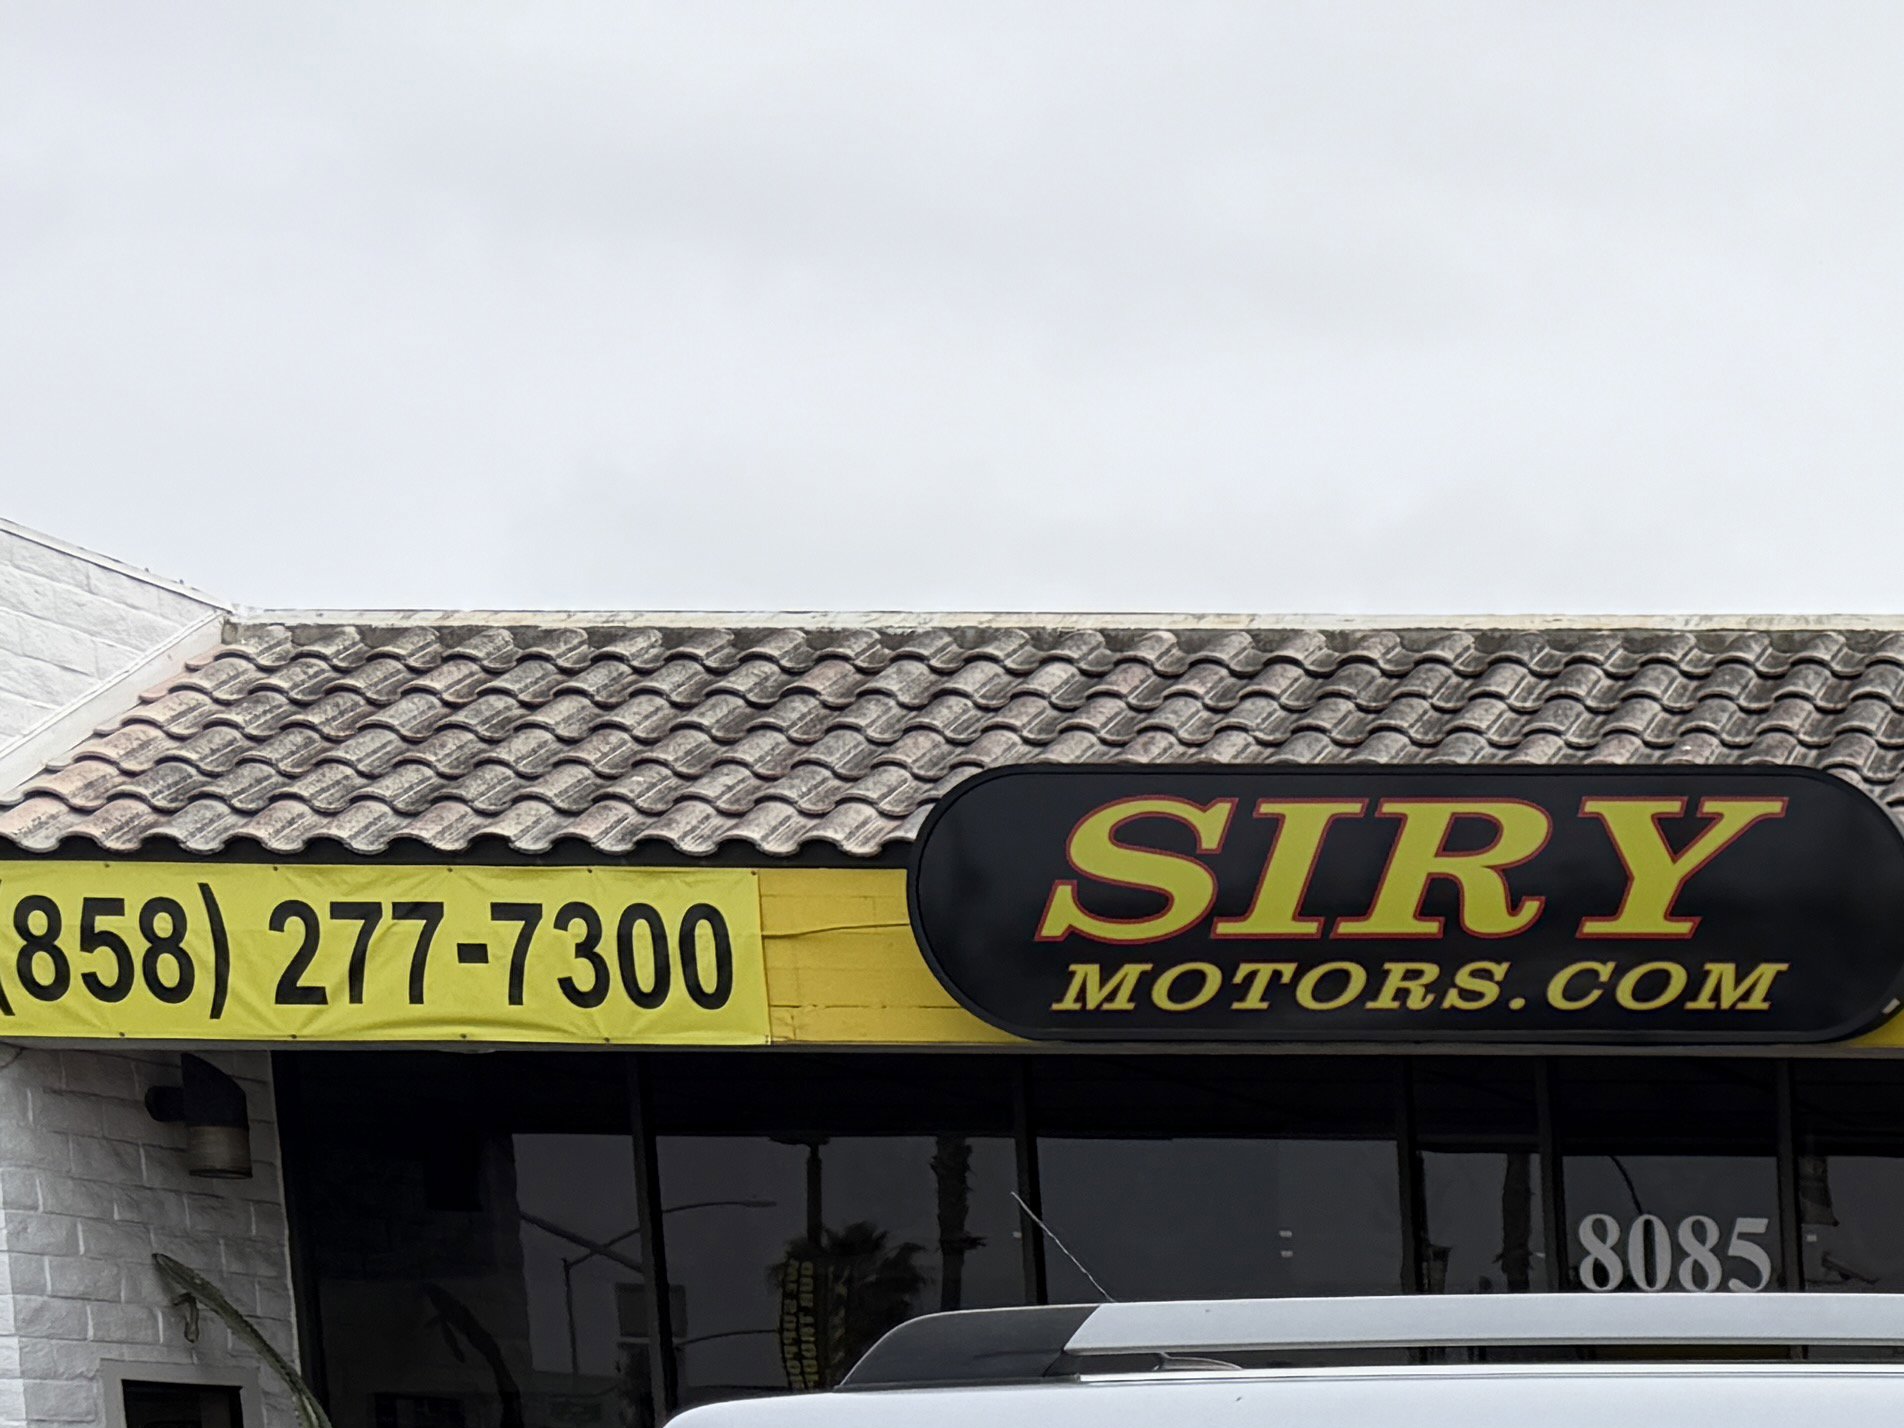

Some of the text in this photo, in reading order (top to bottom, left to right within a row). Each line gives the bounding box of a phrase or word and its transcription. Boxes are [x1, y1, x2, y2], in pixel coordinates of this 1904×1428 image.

[1035, 794, 1789, 943] SIRY
[268, 898, 735, 1010] 277-7300
[1051, 960, 1789, 1013] MOTORS.COM
[1577, 1213, 1773, 1294] 8085
